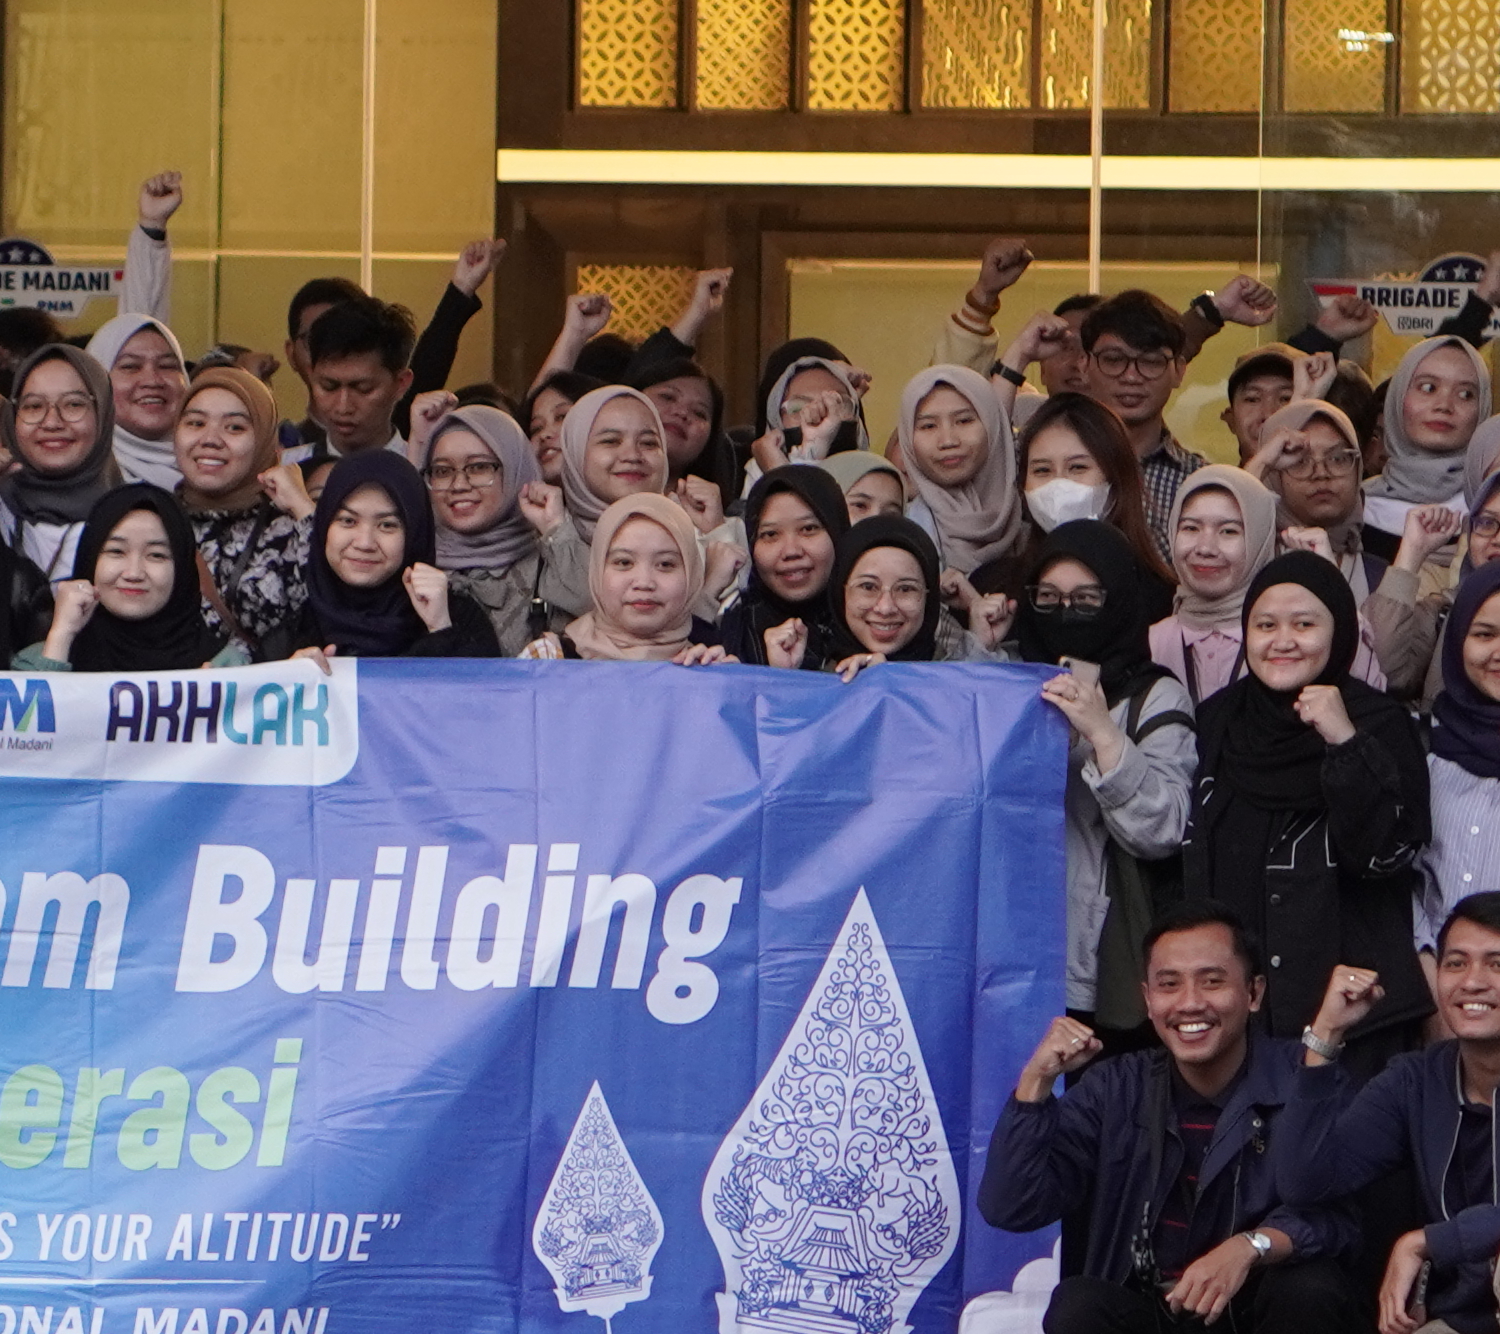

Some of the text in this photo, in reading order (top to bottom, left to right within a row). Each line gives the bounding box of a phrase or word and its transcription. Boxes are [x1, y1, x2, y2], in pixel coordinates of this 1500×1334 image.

[22, 269, 111, 292] MADANI
[1361, 286, 1460, 308] BRIGADE
[106, 680, 330, 747] AKHLAK
[6, 735, 53, 751] Madani
[174, 842, 744, 1025] Building
[37, 1213, 153, 1262] YOUR
[166, 1213, 401, 1263] ALTITUDE”
